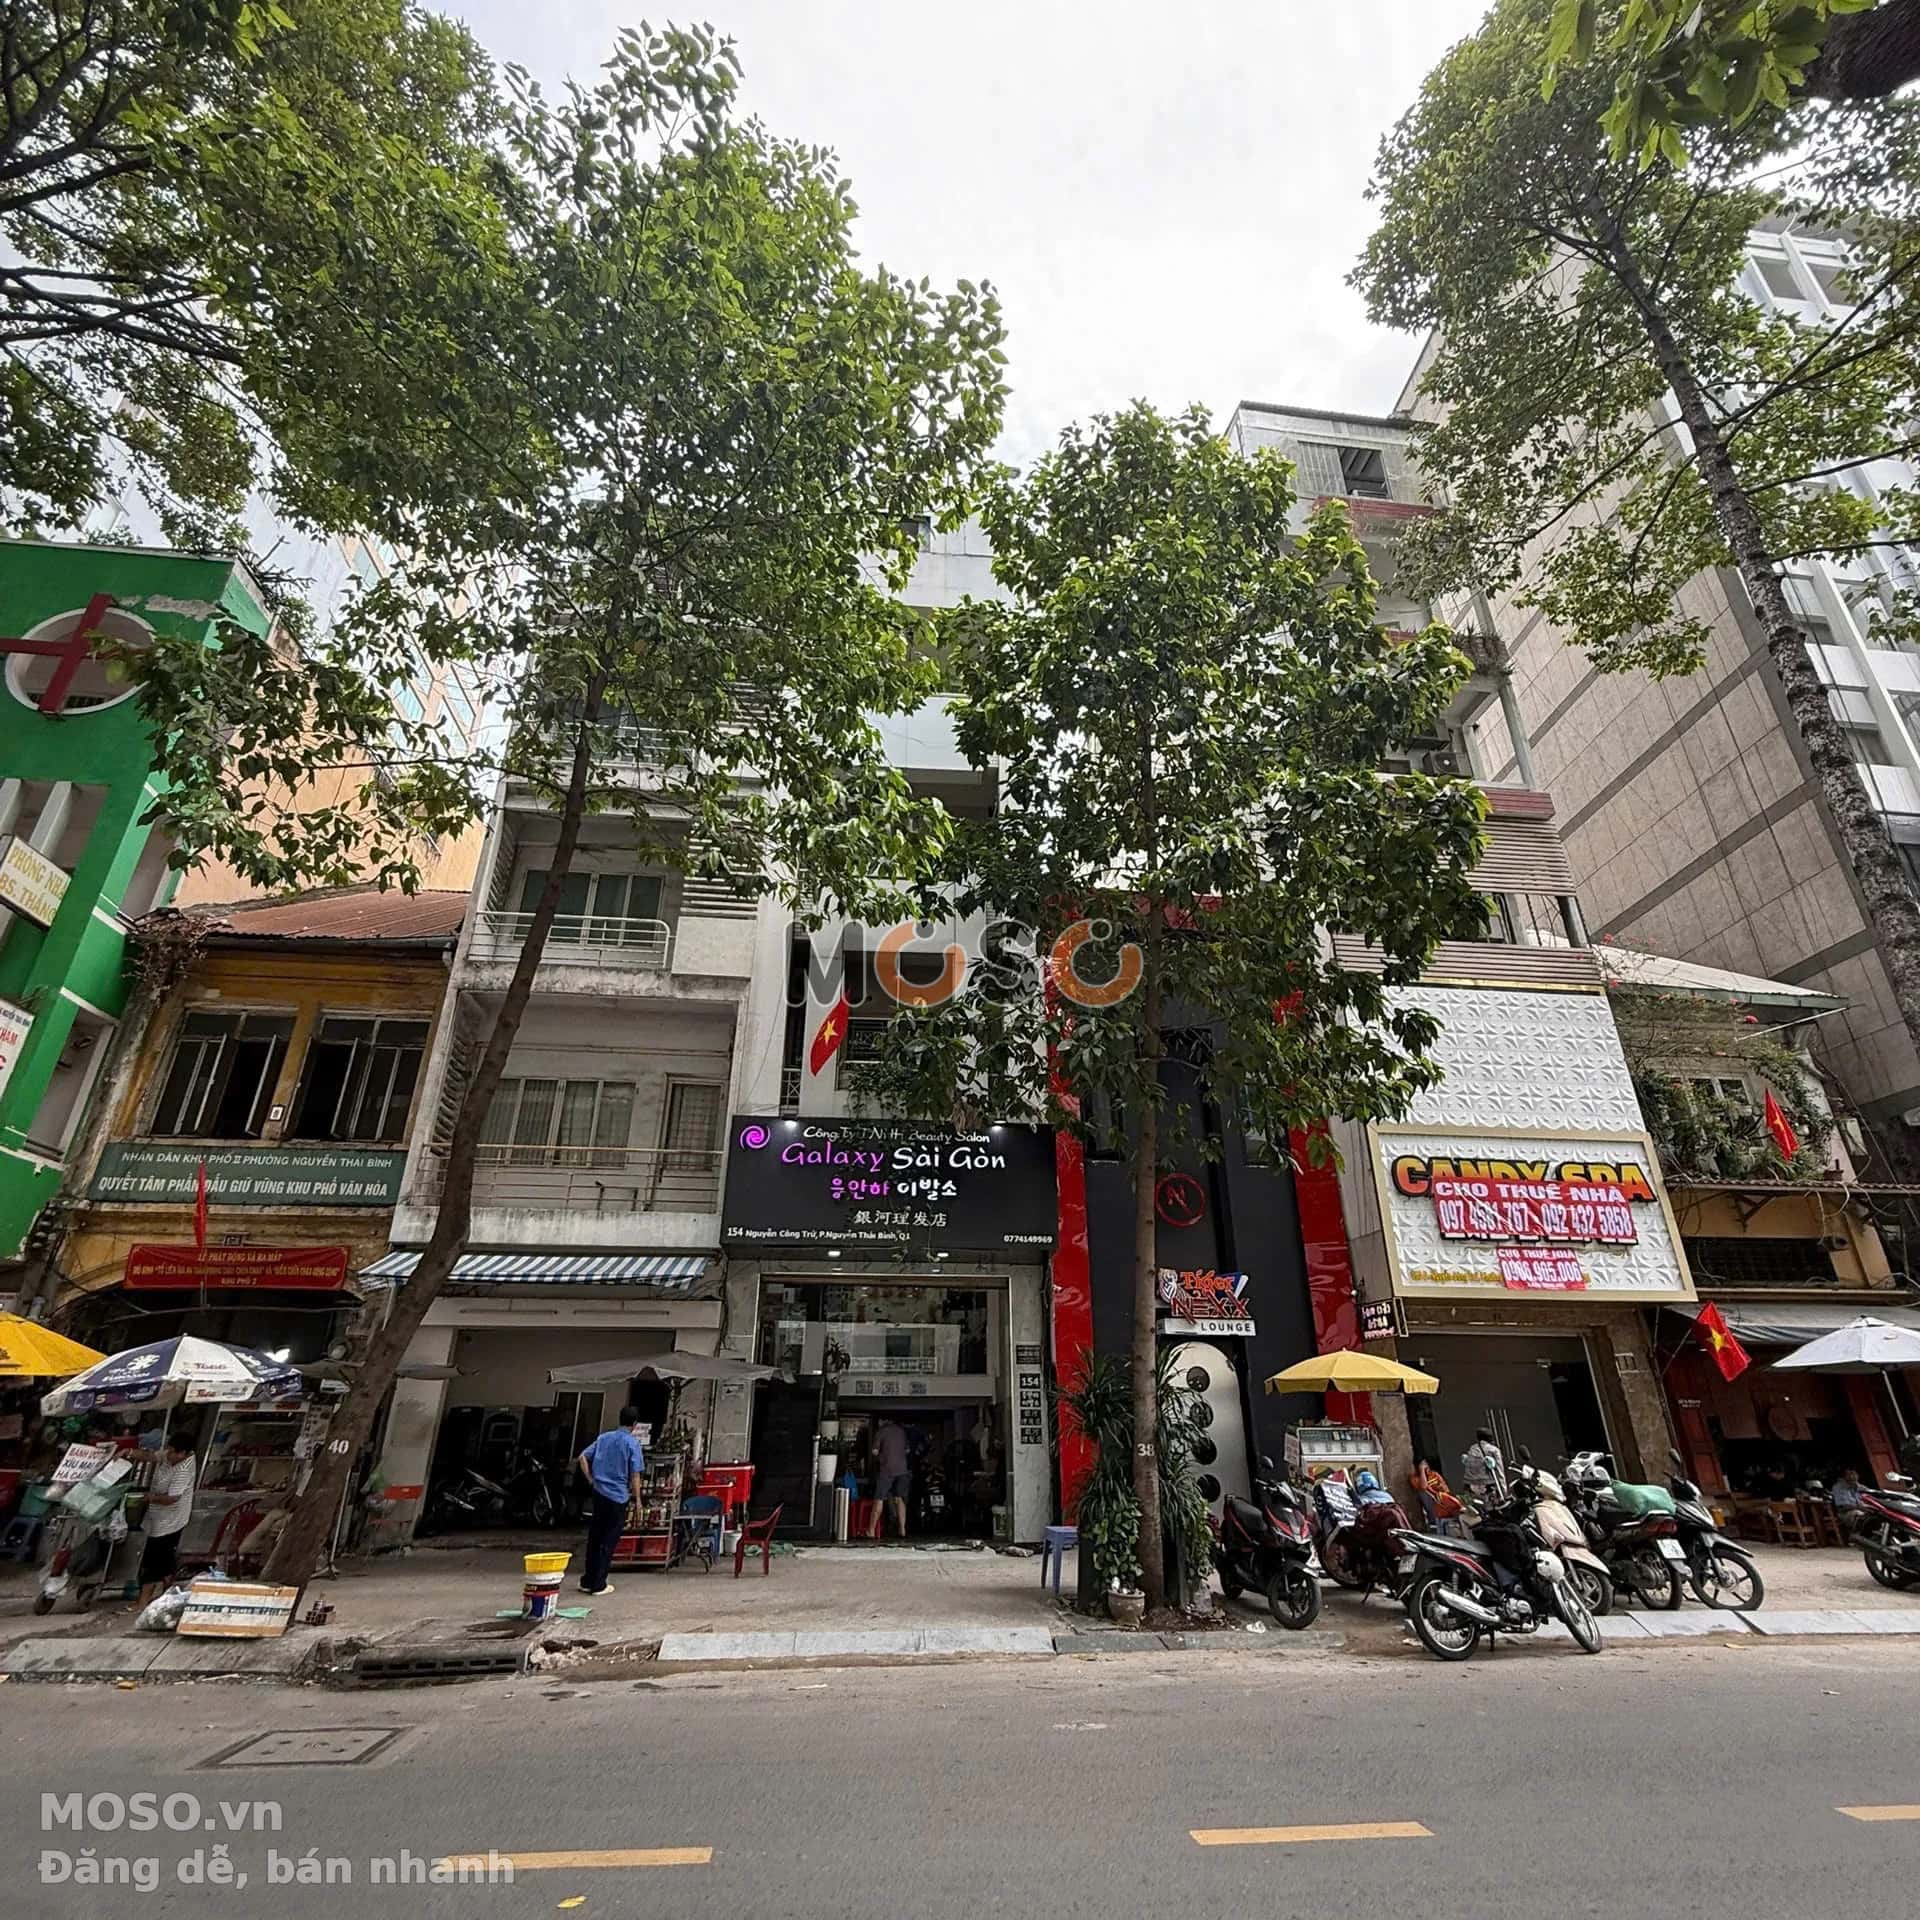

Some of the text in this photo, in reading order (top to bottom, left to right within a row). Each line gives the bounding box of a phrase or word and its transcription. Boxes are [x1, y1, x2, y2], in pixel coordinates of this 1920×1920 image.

[803, 1126, 840, 1142] Công
[954, 1131, 991, 1143] Salon
[183, 1153, 207, 1164] KHU
[208, 1151, 233, 1164] PHỐ
[781, 1140, 1006, 1173] Galaxy Sài Gòn
[98, 1171, 139, 1191] QUYẾT
[138, 1174, 166, 1192] TÂM
[286, 1180, 312, 1195] KHU
[312, 1176, 338, 1195] PHỐ
[897, 1178, 958, 1200] 이발소
[1435, 1181, 1626, 1202] CHO THUÊ NHÀ
[1439, 1199, 1465, 1231] 097
[1503, 1202, 1530, 1233] 767
[1541, 1203, 1569, 1234] 092
[1570, 1204, 1597, 1236] 432
[1597, 1206, 1633, 1237] 5858
[727, 1227, 744, 1237] 154
[1180, 1269, 1236, 1292] Tiger
[1201, 1322, 1251, 1332] LOUNGE
[1021, 1376, 1039, 1387] 154
[328, 1439, 350, 1454] 40
[1136, 1443, 1155, 1457] 38
